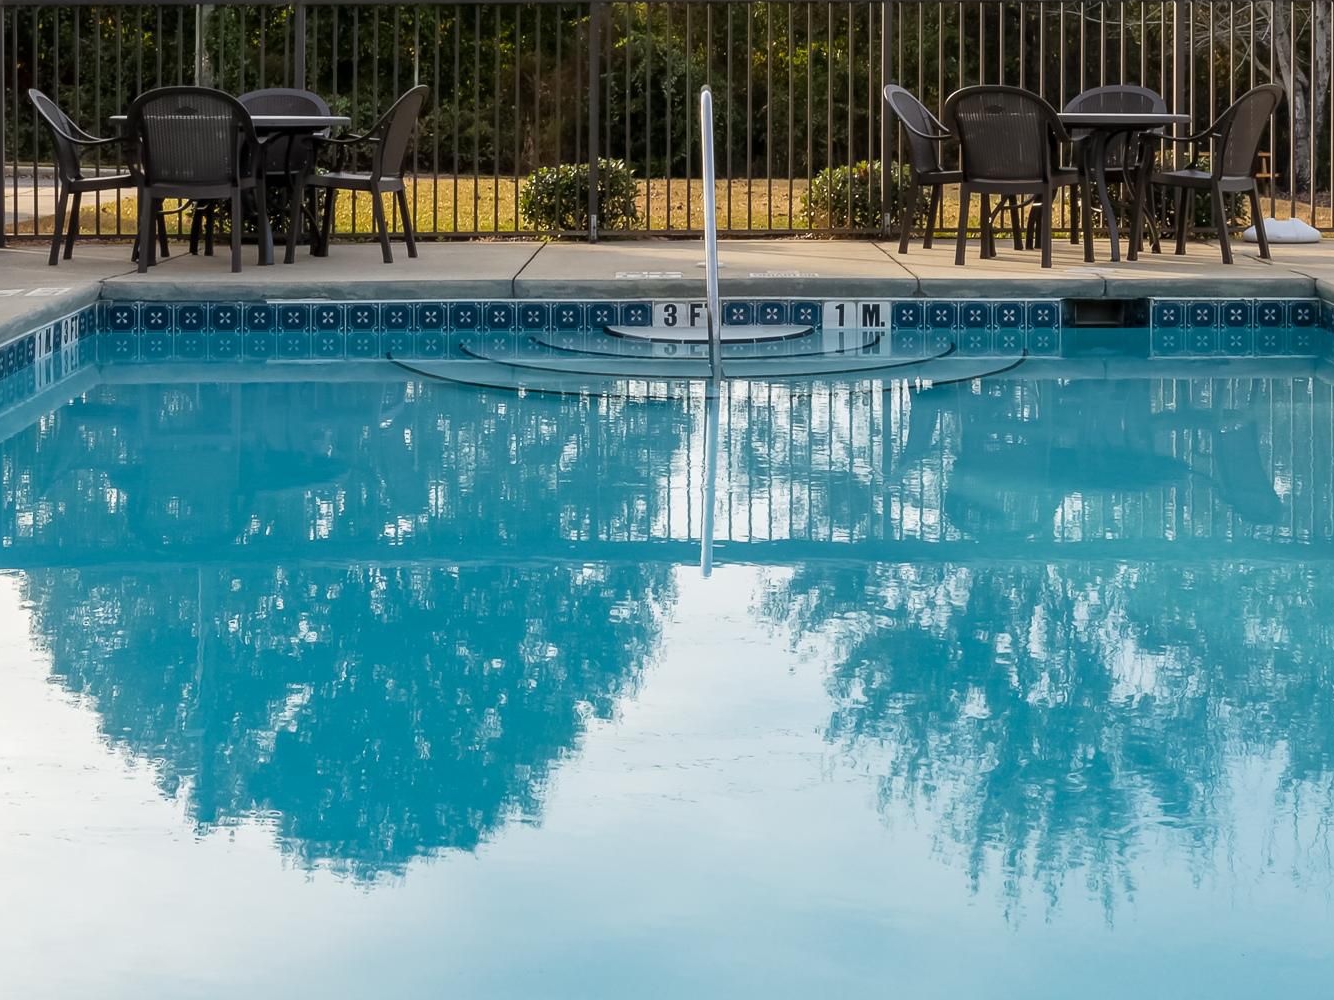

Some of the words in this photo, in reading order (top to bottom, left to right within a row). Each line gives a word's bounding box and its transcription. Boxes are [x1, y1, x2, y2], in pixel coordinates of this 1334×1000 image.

[663, 303, 678, 327] 3
[689, 303, 709, 327] F
[834, 303, 845, 327] 1
[862, 303, 886, 328] M.
[38, 331, 42, 358] 1
